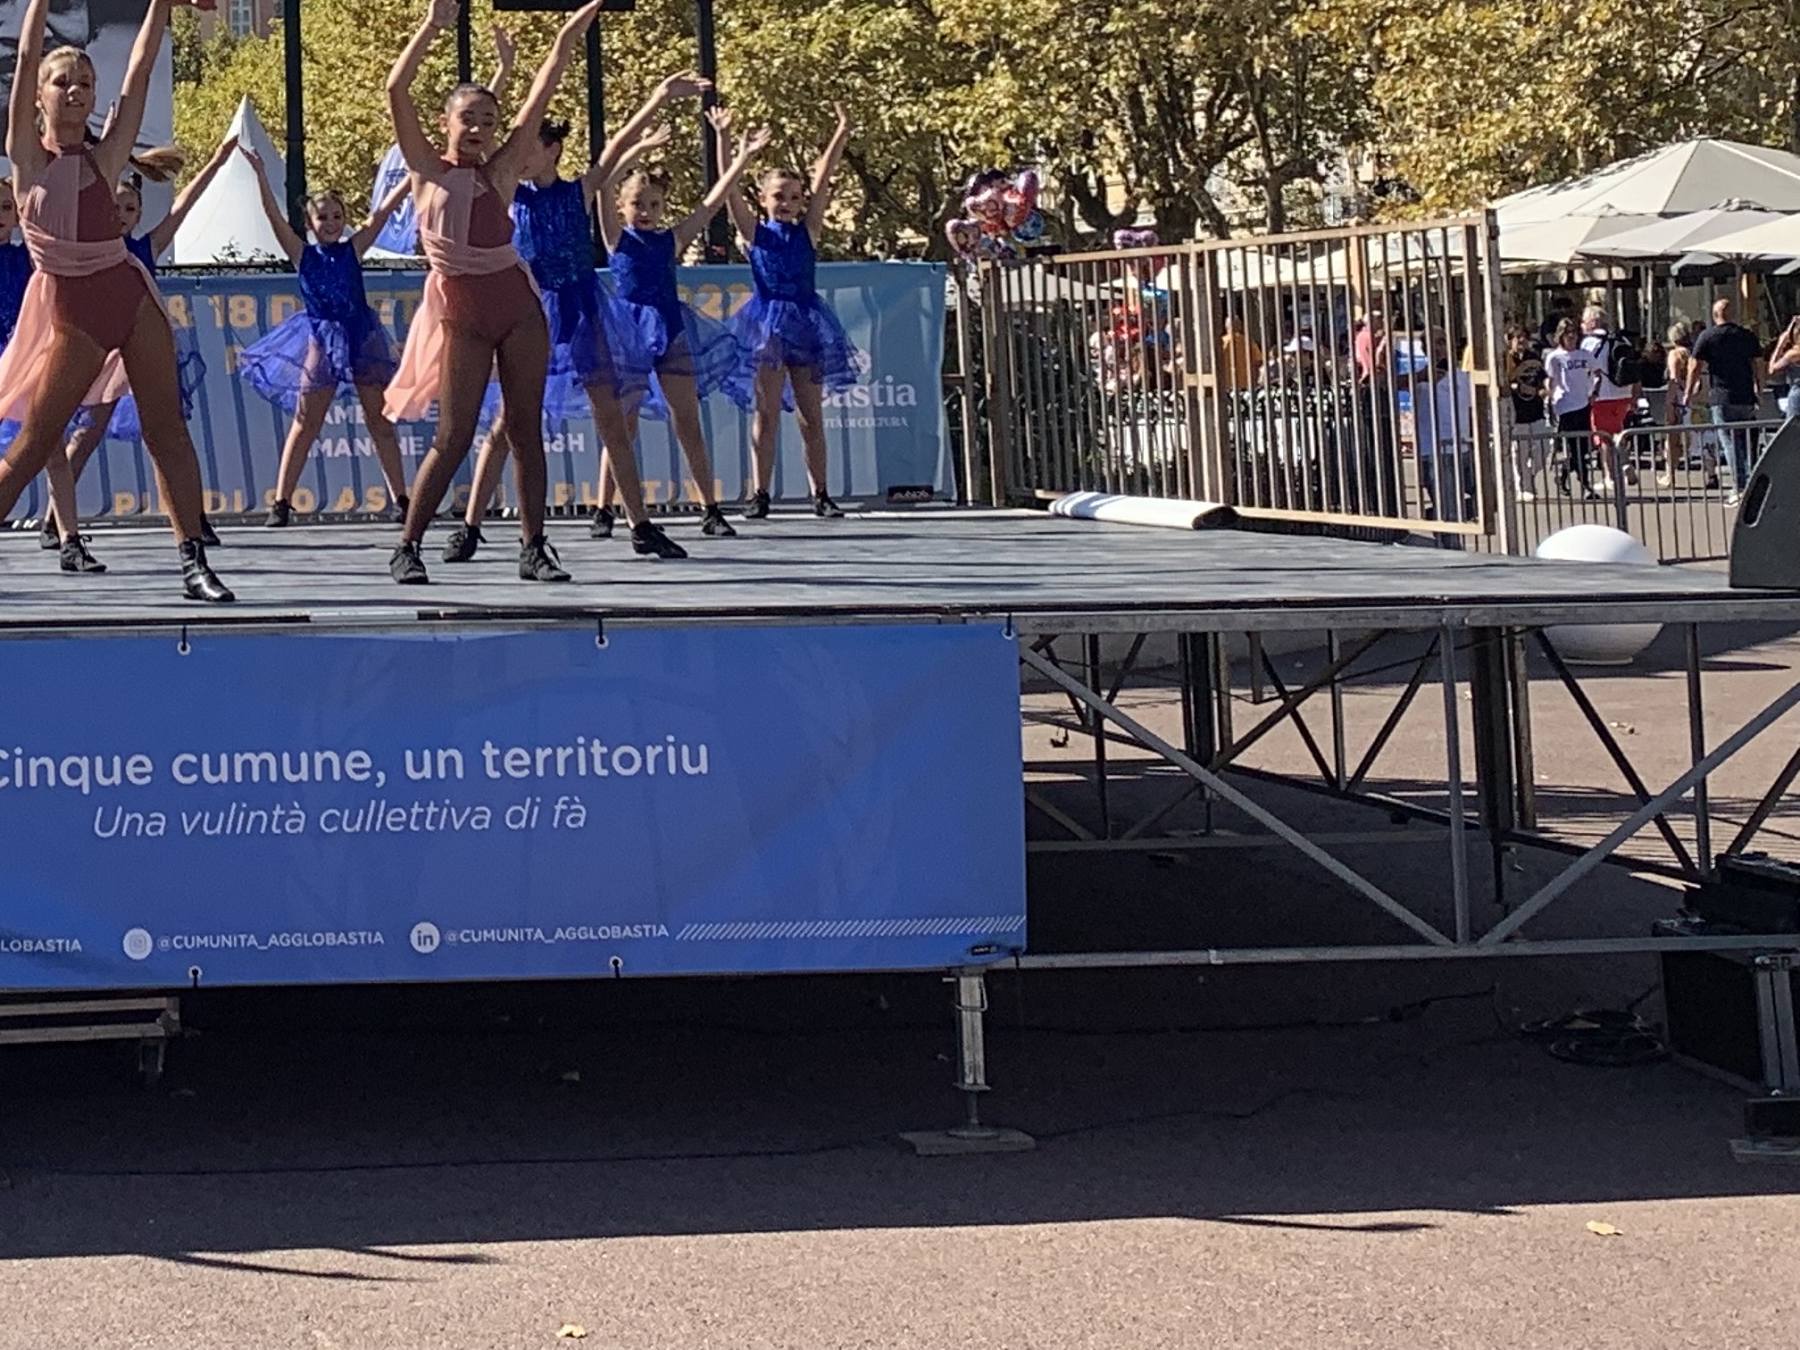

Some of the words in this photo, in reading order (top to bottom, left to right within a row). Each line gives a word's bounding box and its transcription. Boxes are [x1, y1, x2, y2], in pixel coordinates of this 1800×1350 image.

[207, 294, 258, 328] 18
[171, 749, 387, 788] cumune,
[404, 748, 465, 780] un
[481, 734, 709, 778] territoriu
[93, 805, 167, 838] Una
[180, 800, 307, 836] vulintà
[318, 798, 492, 833] cullettiva
[504, 796, 542, 830] di
[552, 794, 587, 829] fà
[156, 931, 385, 951] @CUMUNITA_AGGLOBASTIA
[444, 924, 670, 947] @CUMUNITA_AGGLOBASTIA
